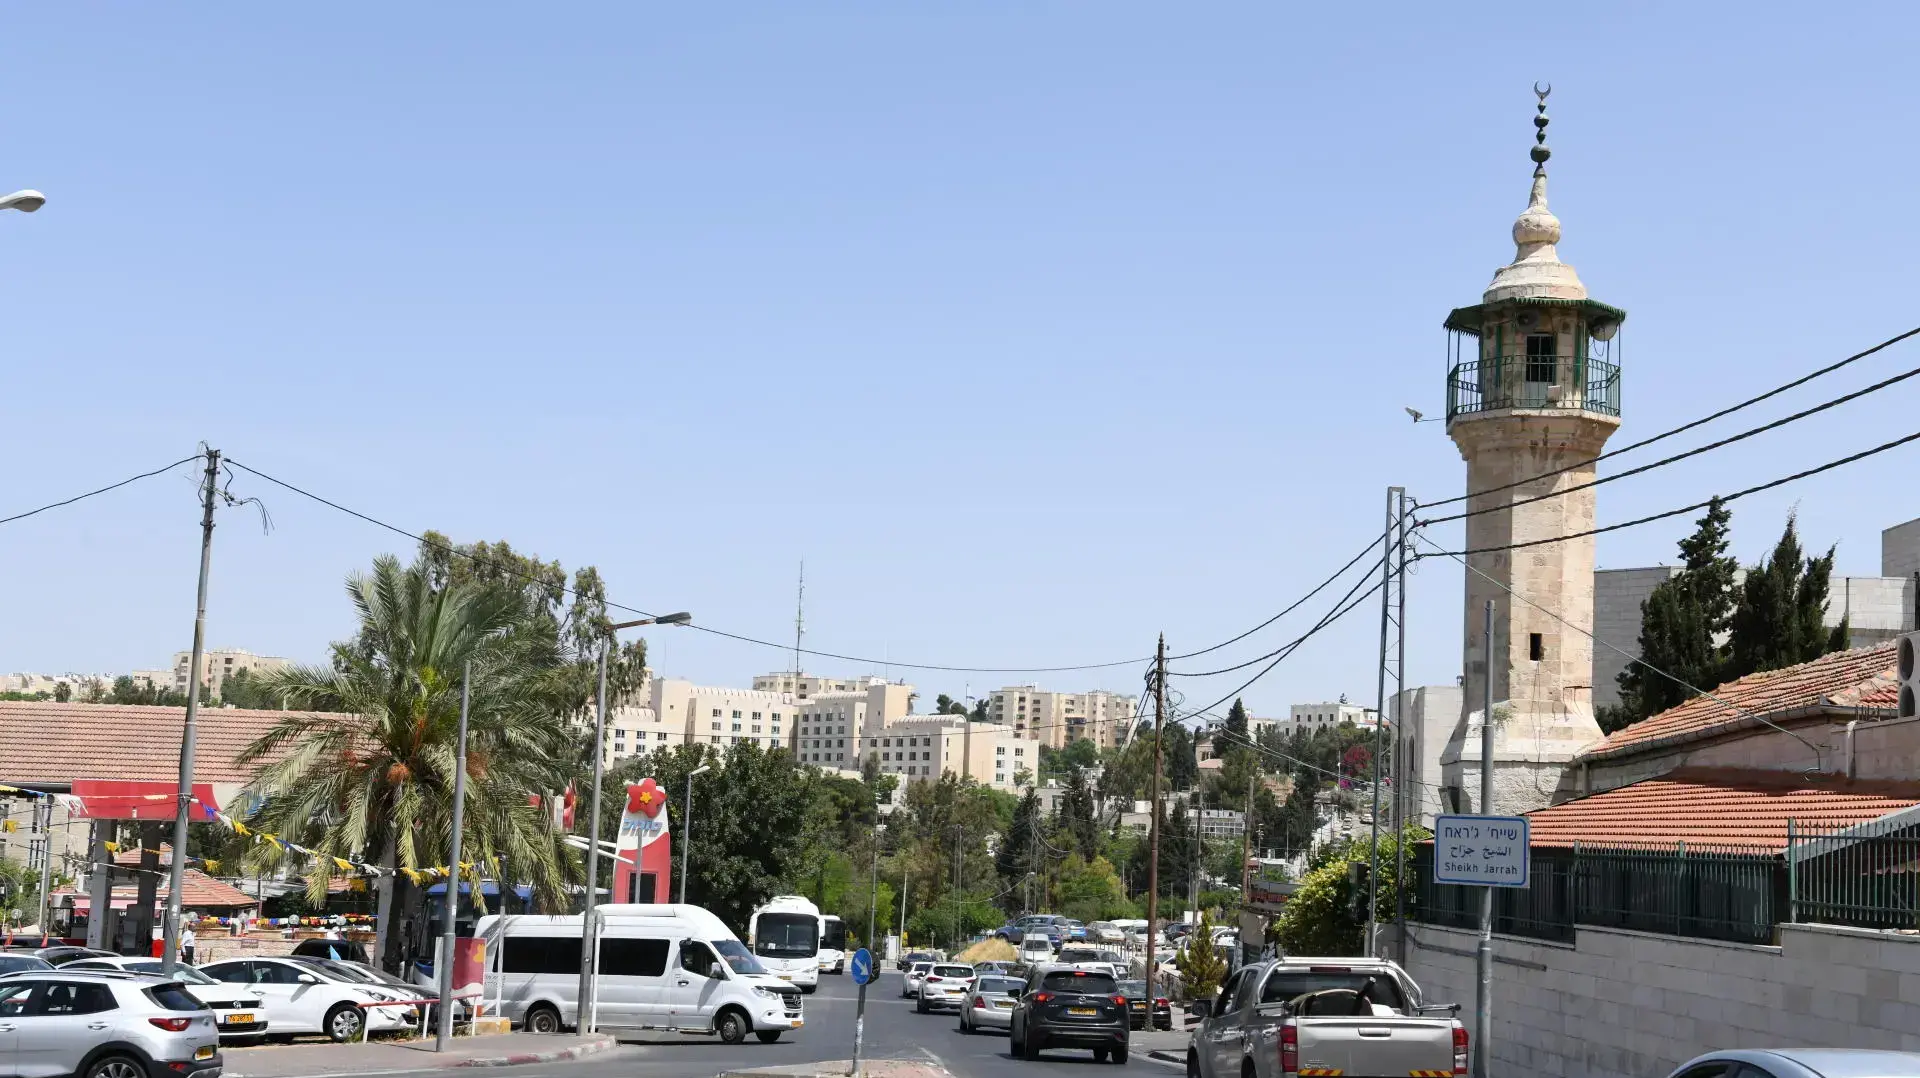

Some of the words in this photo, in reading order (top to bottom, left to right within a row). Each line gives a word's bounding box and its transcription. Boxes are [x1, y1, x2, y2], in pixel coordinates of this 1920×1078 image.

[1445, 825, 1479, 838] ג'ראח
[1487, 826, 1518, 840] שייח'
[1482, 846, 1511, 859] الشيخ
[1444, 862, 1478, 872] Sheikh
[1484, 864, 1518, 874] Jarrah
